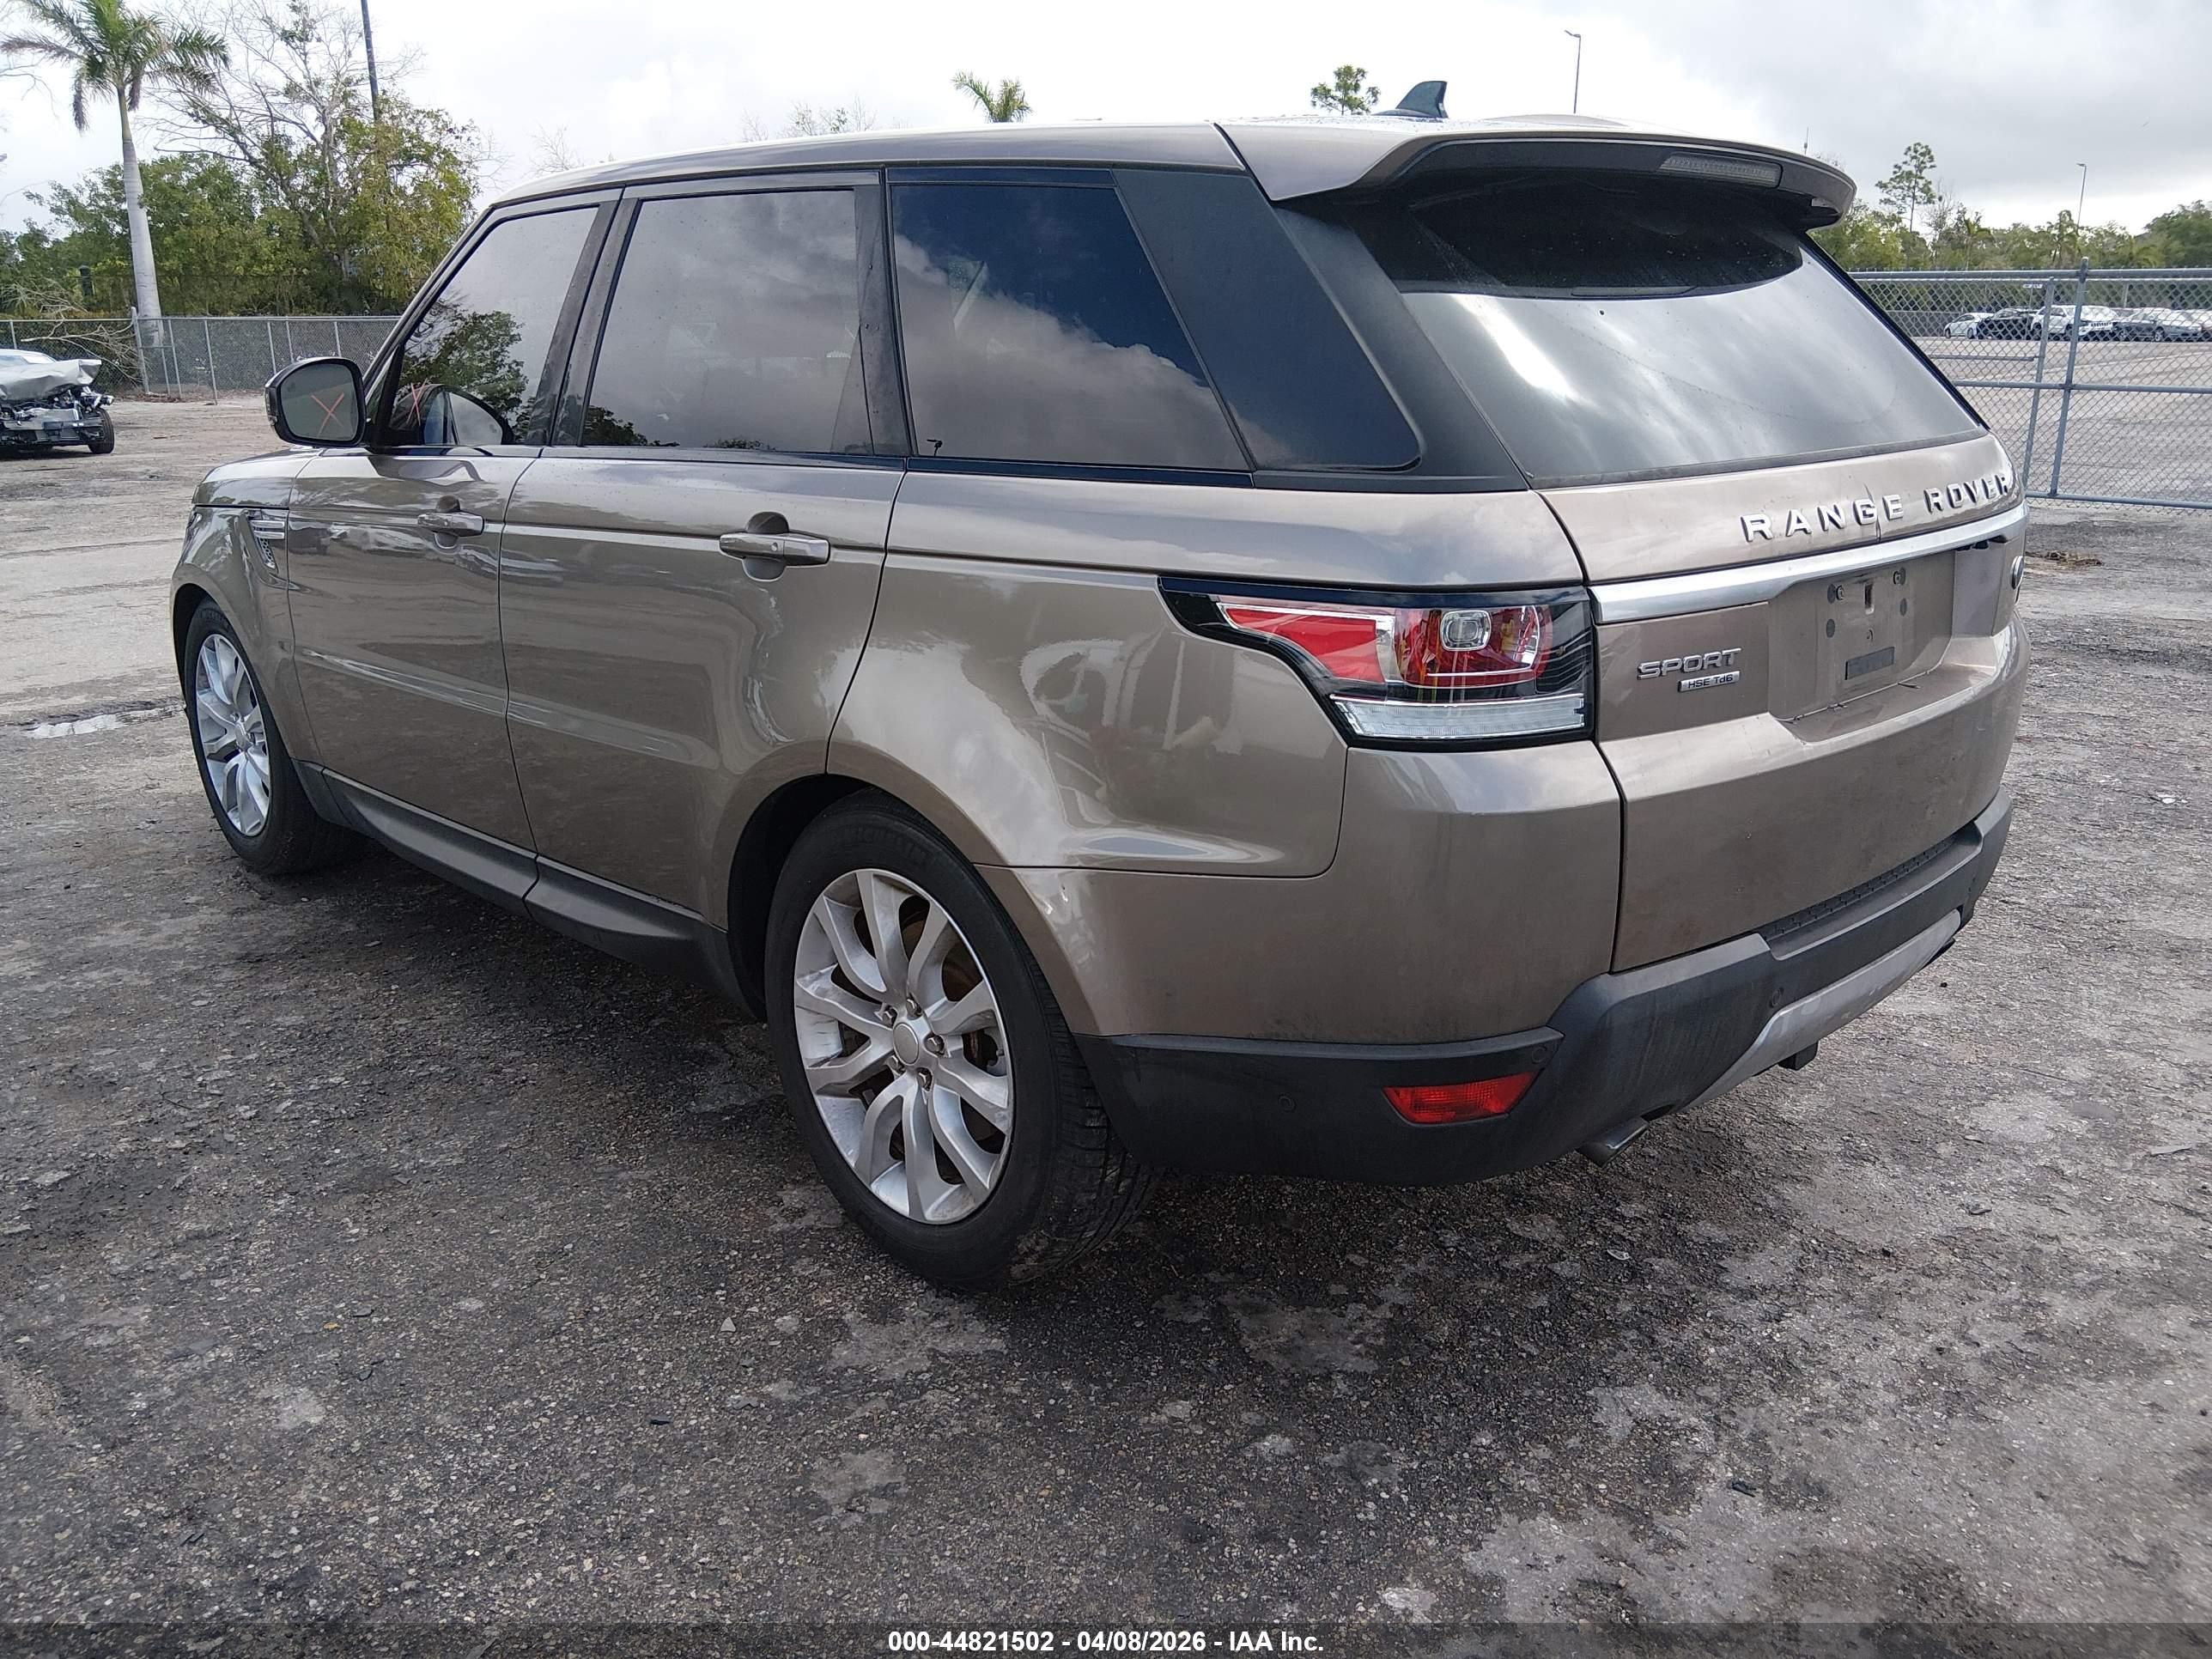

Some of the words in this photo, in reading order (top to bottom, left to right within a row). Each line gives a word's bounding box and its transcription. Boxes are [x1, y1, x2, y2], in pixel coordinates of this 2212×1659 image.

[1740, 494, 1904, 543] RANGE
[1923, 474, 2010, 515] ROVER
[1637, 647, 1741, 680] SPORT
[1687, 678, 1711, 689] HSE
[1713, 673, 1734, 684] Td6
